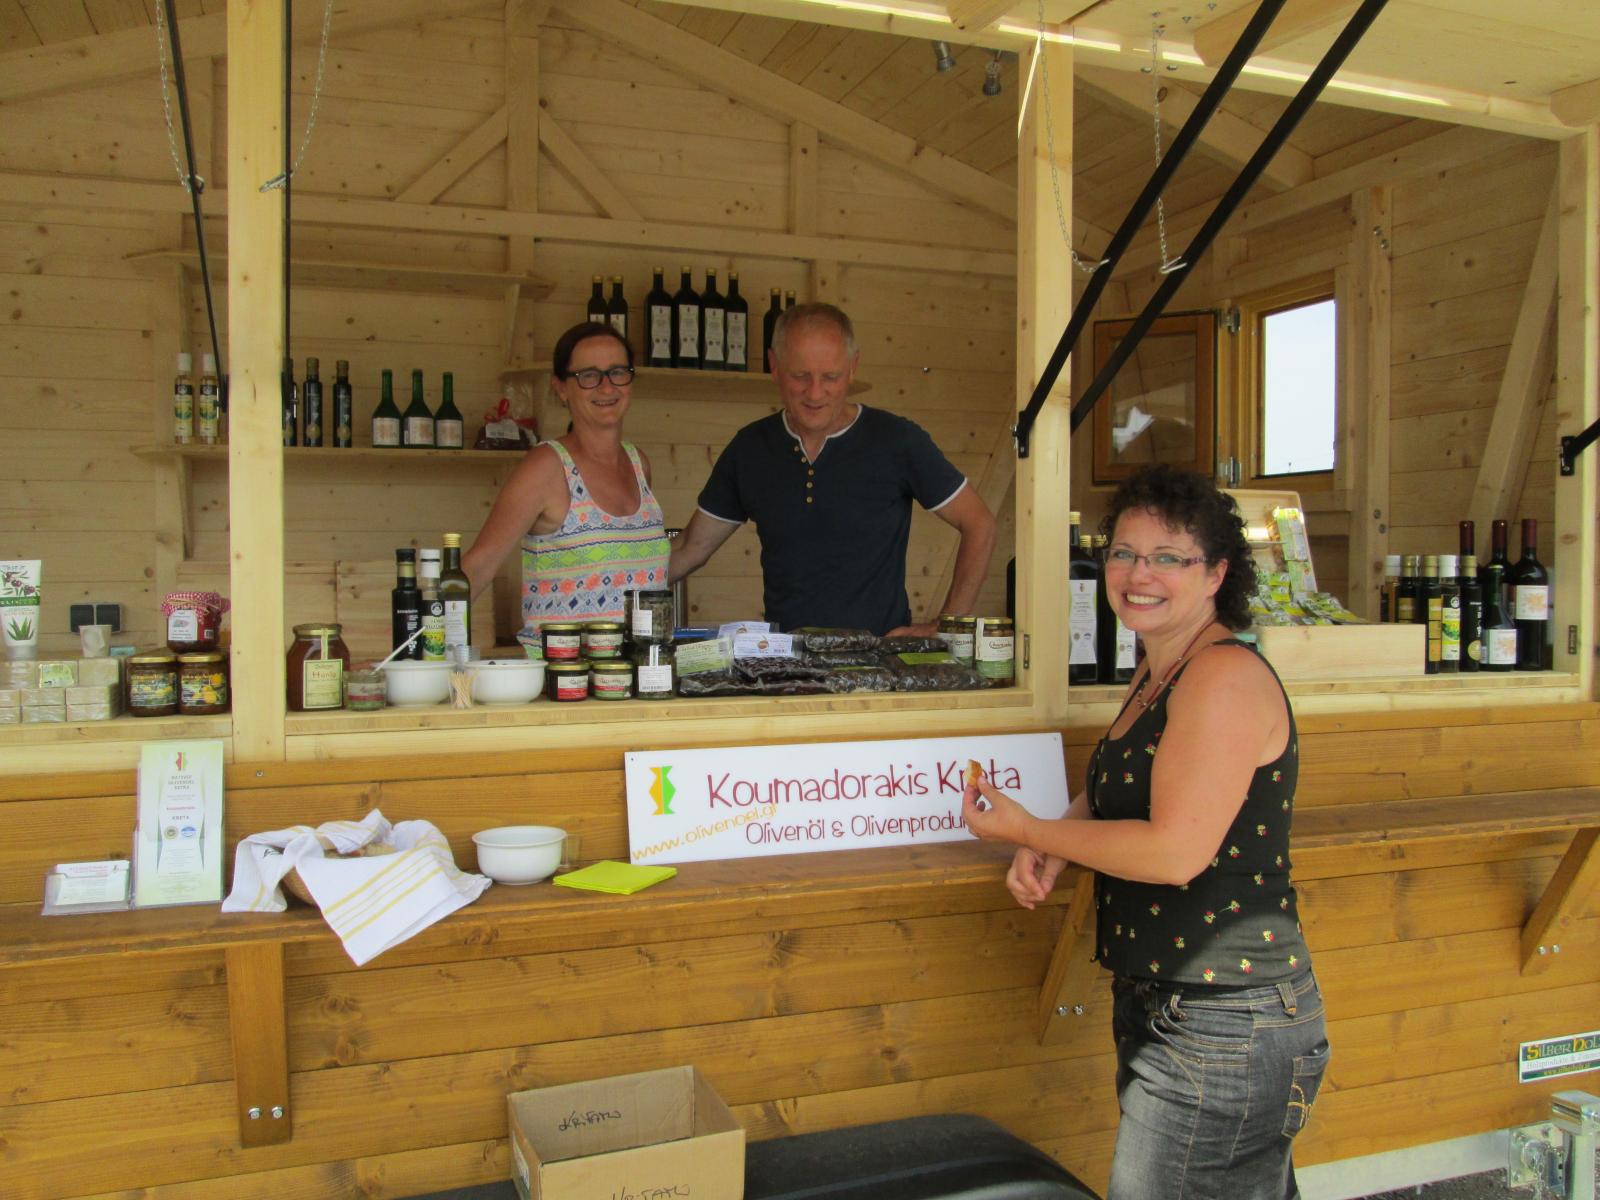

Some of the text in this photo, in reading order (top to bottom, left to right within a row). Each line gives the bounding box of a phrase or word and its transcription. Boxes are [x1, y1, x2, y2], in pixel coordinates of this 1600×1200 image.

[707, 759, 1021, 808] Koumadorakis Krta
[746, 819, 824, 844] Olivenöl
[831, 820, 845, 838] &
